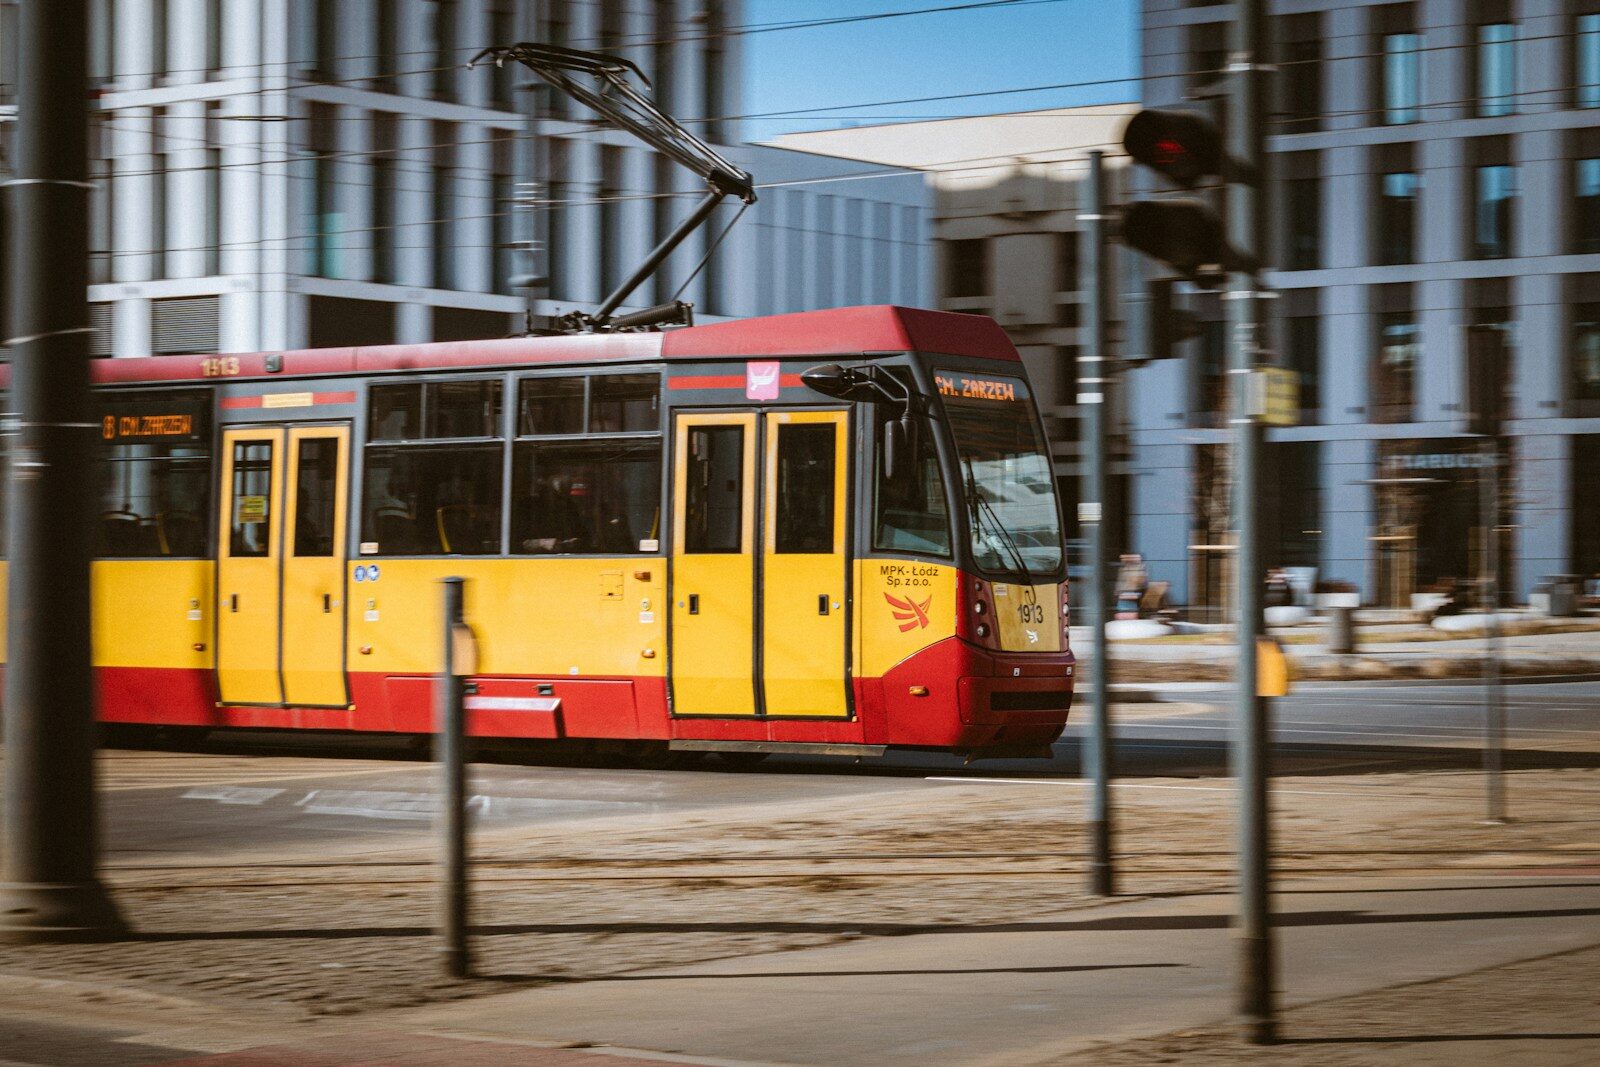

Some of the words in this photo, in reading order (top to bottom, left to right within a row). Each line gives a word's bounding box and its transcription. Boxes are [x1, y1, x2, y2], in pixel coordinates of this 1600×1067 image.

[961, 379, 1015, 401] ZARZEW
[887, 575, 903, 588] Sp.
[912, 578, 931, 587] o.o.
[1017, 603, 1044, 624] 1913
